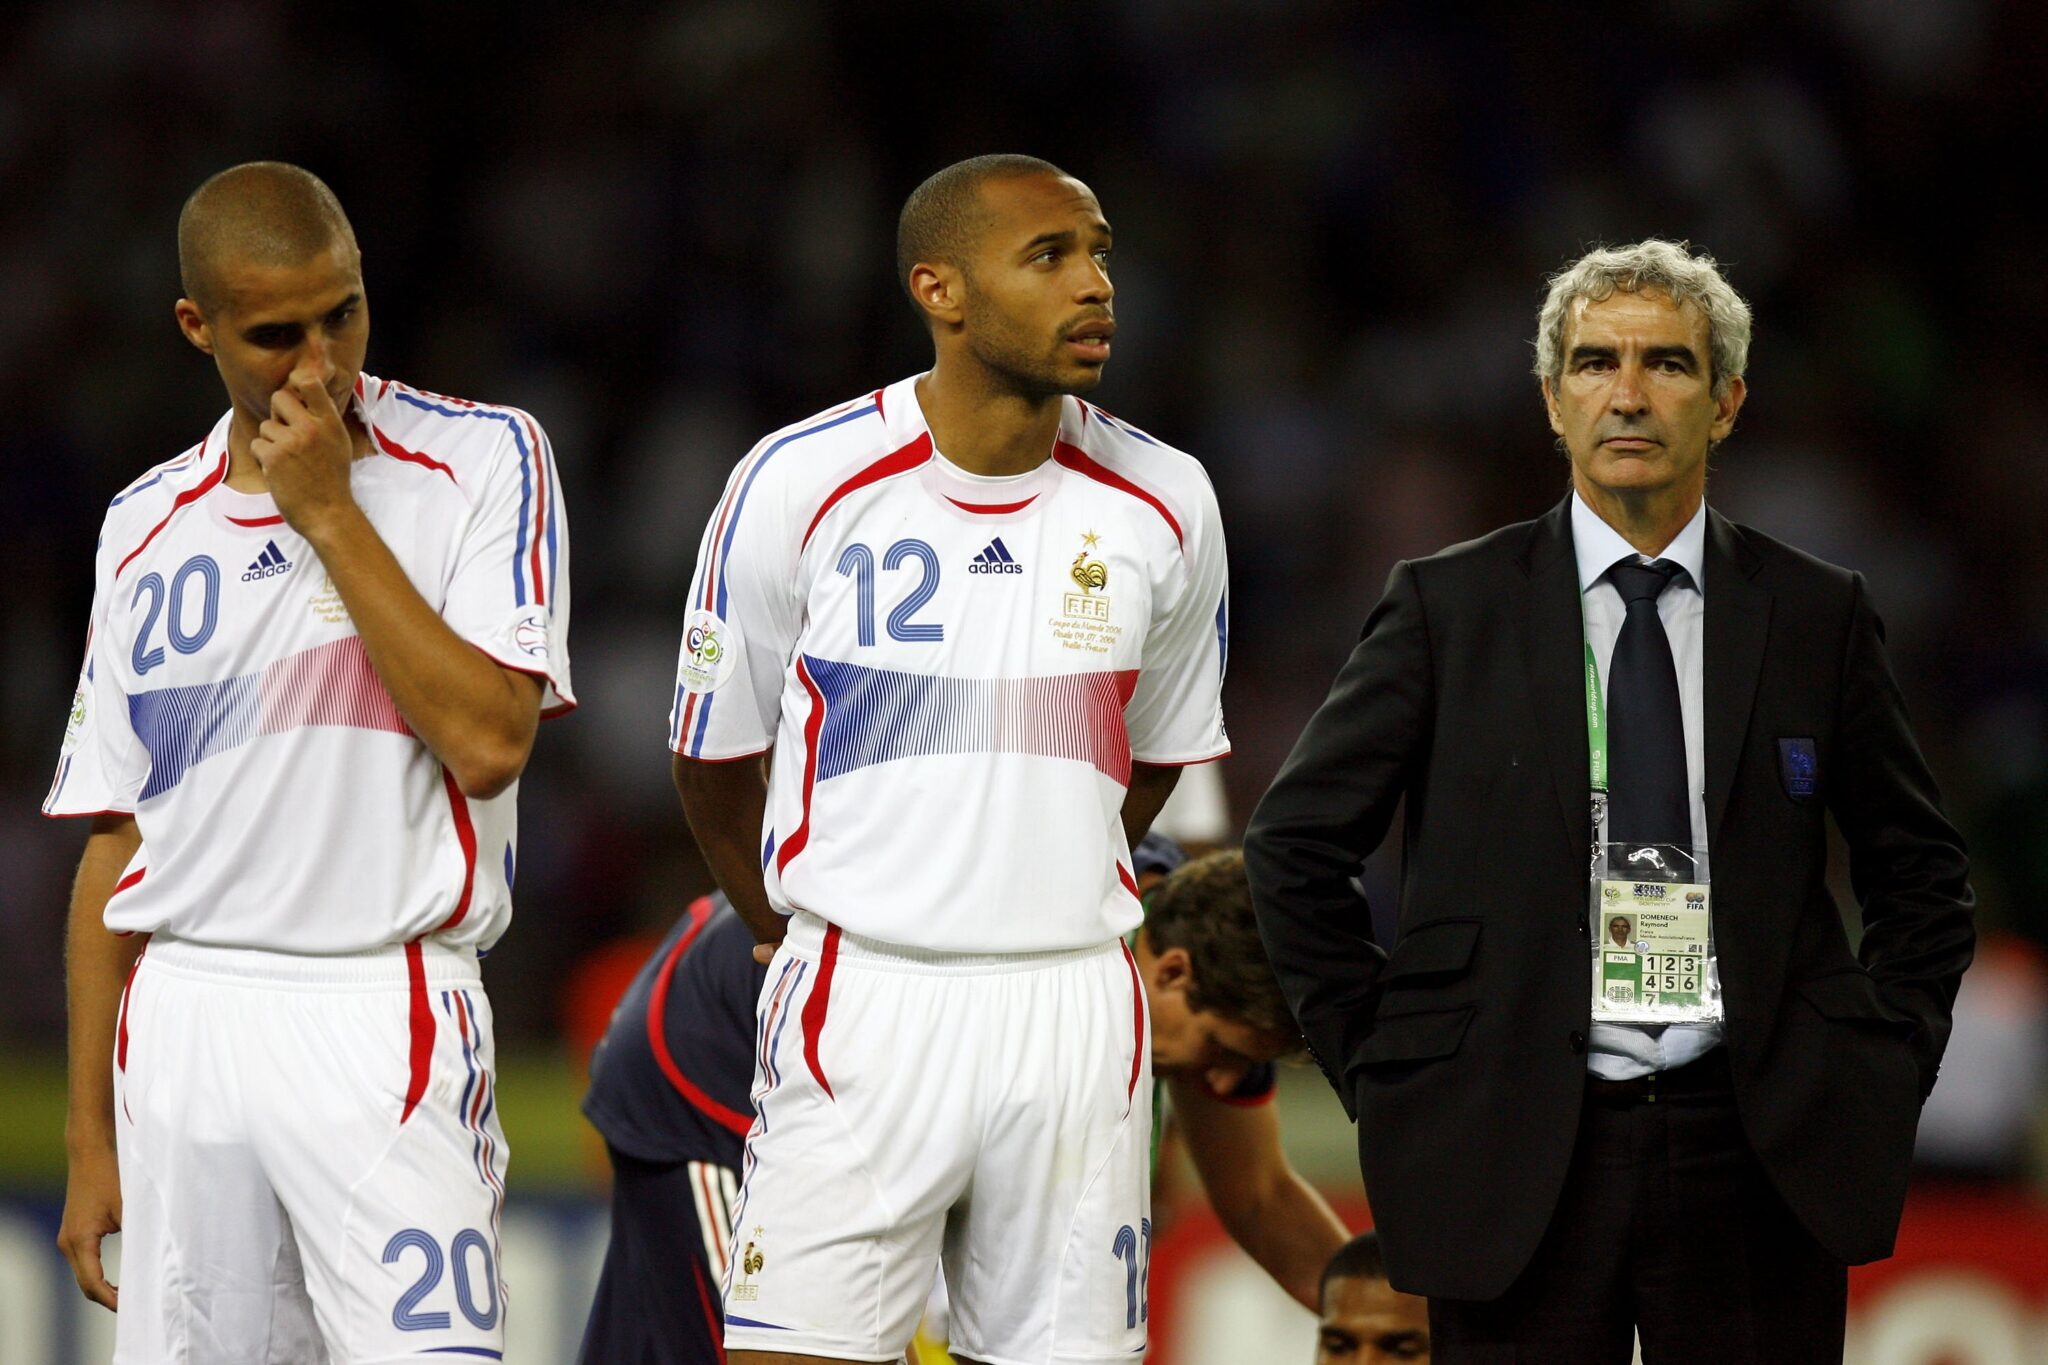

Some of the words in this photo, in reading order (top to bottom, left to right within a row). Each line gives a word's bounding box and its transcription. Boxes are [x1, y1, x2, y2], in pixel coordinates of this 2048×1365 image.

[241, 561, 293, 582] adidas
[968, 561, 1023, 574] adidas
[836, 538, 944, 647] 12
[130, 554, 220, 676] 20
[1686, 903, 1705, 911] FIFA
[1640, 913, 1679, 921] DOMENECH
[1640, 921, 1669, 929] Raymond
[1613, 954, 1628, 962] PMA
[1647, 956, 1655, 970] 1
[1665, 957, 1676, 971] 2
[1684, 958, 1694, 972] 3
[1645, 975, 1656, 988] 4
[1665, 976, 1675, 989] 5
[1684, 977, 1694, 990] 6
[1645, 993, 1656, 1006] 7
[382, 1228, 498, 1331] 20
